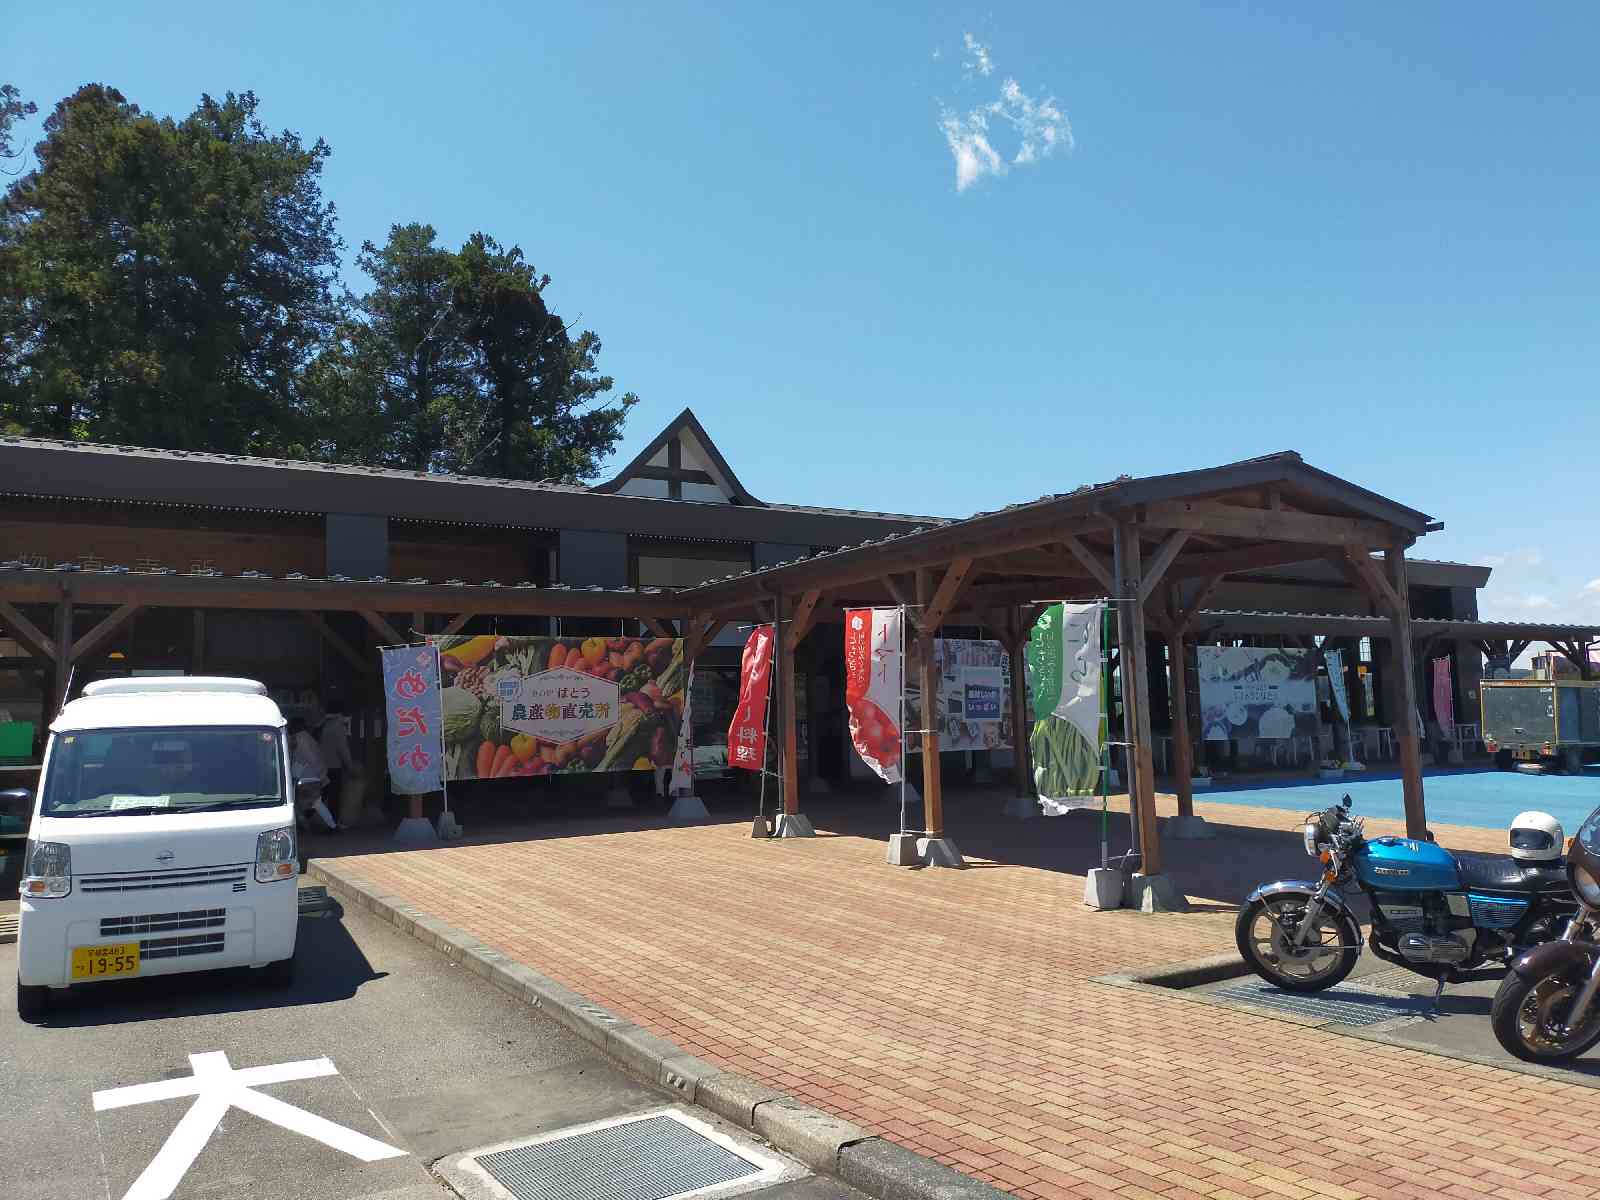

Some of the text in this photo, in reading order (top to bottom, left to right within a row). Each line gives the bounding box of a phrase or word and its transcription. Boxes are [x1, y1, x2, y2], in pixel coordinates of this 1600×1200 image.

[512, 703, 610, 721] 農産物直売所
[89, 955, 136, 975] 19-55
